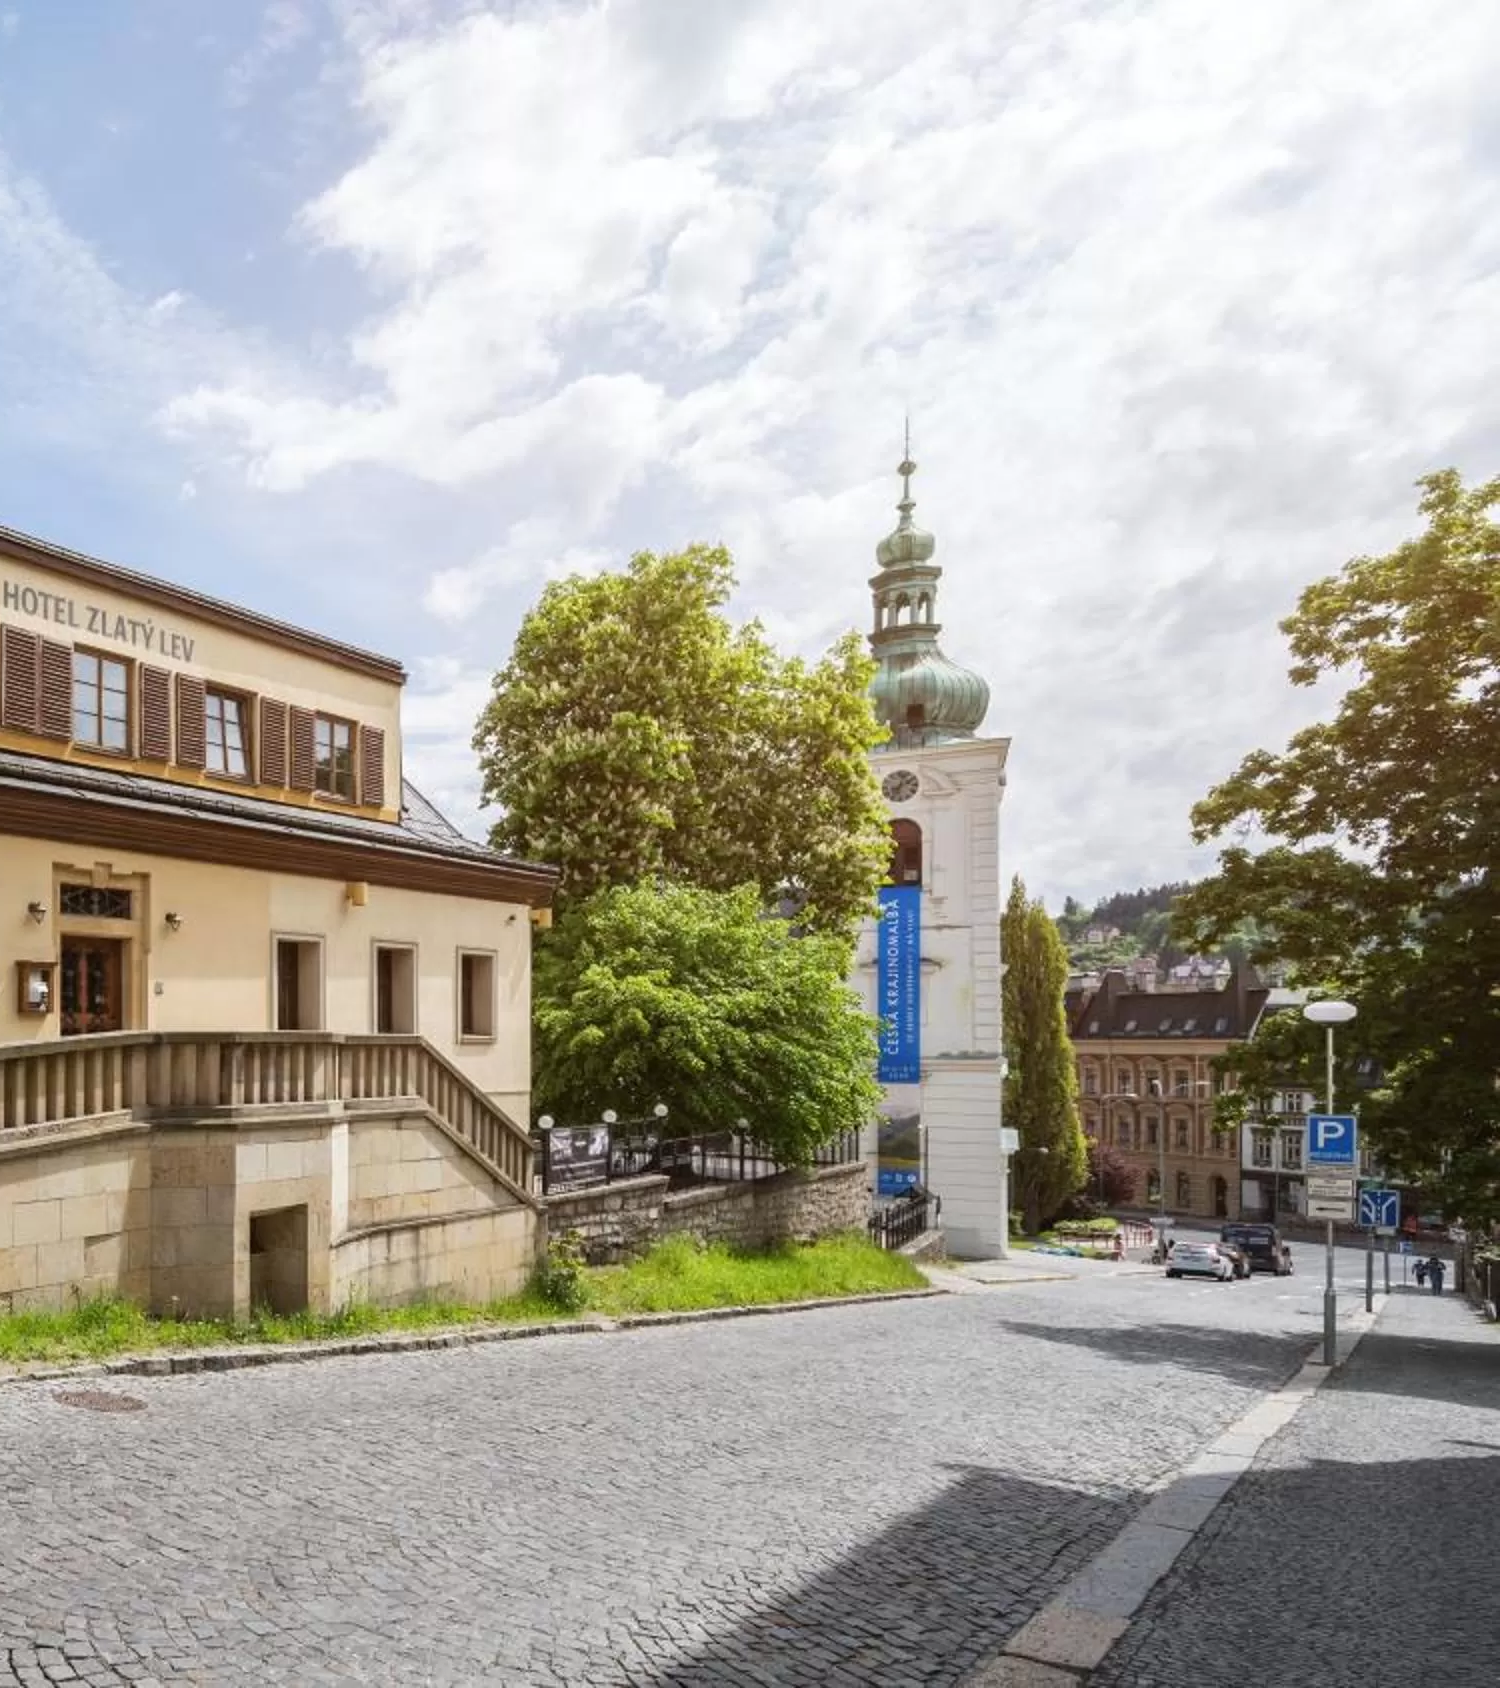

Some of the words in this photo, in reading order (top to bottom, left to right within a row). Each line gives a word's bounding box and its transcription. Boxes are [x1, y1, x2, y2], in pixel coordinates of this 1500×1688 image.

[2, 580, 80, 628] HOTEL
[85, 605, 155, 650] ZLATÝ
[160, 630, 195, 662] LEV
[1317, 1121, 1345, 1149] P
